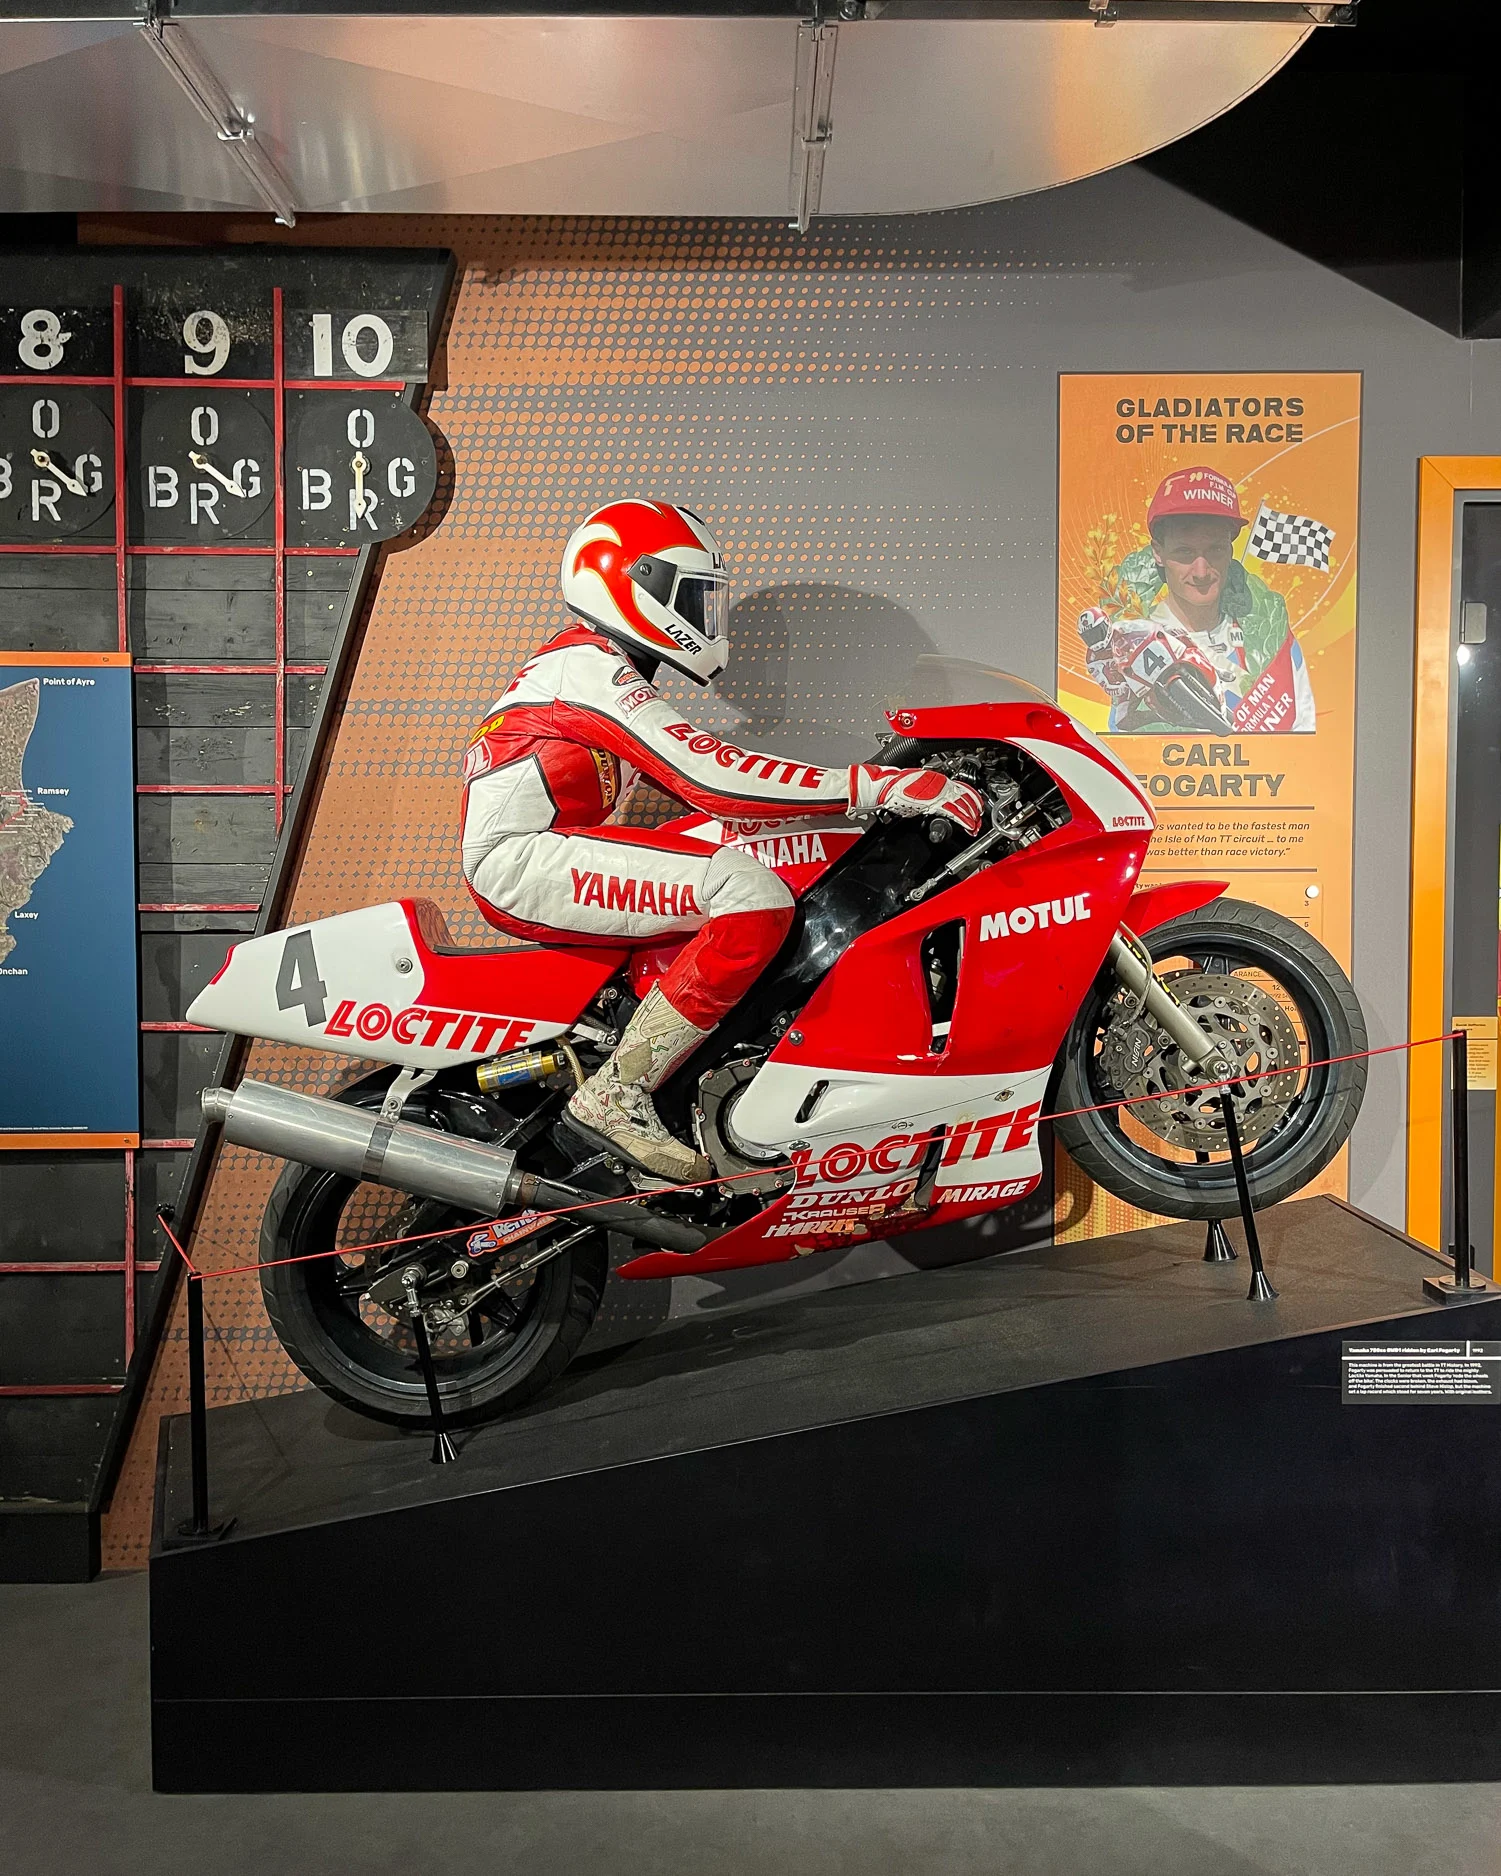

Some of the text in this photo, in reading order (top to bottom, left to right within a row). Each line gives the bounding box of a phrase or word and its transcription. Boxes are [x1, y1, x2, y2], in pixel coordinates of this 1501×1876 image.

[18, 309, 70, 370] 8
[183, 310, 230, 375] 9
[312, 313, 394, 377] 10
[1115, 397, 1305, 419] GLADIATORS
[1115, 423, 1303, 444] OF THE RACE
[75, 453, 103, 493] G
[148, 465, 179, 508] B
[232, 458, 261, 498] G
[302, 468, 332, 510] B
[388, 457, 416, 498] G
[31, 479, 61, 521] R
[190, 482, 220, 525] R
[349, 488, 379, 531] R
[1183, 489, 1234, 509] WINNER
[664, 623, 703, 657] LAZER
[1142, 647, 1166, 676] 4
[43, 677, 96, 688] Point of Ayre
[1236, 702, 1252, 722] OF
[1248, 673, 1276, 707] MAN
[662, 722, 829, 790] LOCTITE
[1162, 743, 1250, 767] CARL
[37, 786, 70, 796] Ramsey
[1112, 815, 1146, 828] LOCTITE
[1164, 834, 1182, 844] Isle
[1184, 834, 1196, 844] of
[1196, 834, 1218, 844] Man
[1220, 834, 1232, 844] TT
[1233, 834, 1266, 844] circuit
[1276, 834, 1287, 844] to
[1288, 836, 1304, 844] me
[1166, 821, 1204, 831] wanted
[1206, 822, 1216, 831] to
[1218, 821, 1230, 831] be
[1232, 821, 1249, 831] the
[1251, 821, 1286, 831] fastest
[1288, 822, 1310, 831] man
[1168, 846, 1200, 857] better
[1201, 846, 1223, 857] than
[1226, 848, 1248, 857] race
[570, 867, 704, 918] YAMAHA
[14, 910, 39, 920] Laxey
[980, 893, 1091, 942] MOTUL
[275, 929, 329, 1027] 4
[324, 1000, 537, 1054] LOCTITE
[789, 1099, 1042, 1190] LOCTITE
[788, 1178, 918, 1209] DUNLO
[936, 1179, 1031, 1205] MIRAGE
